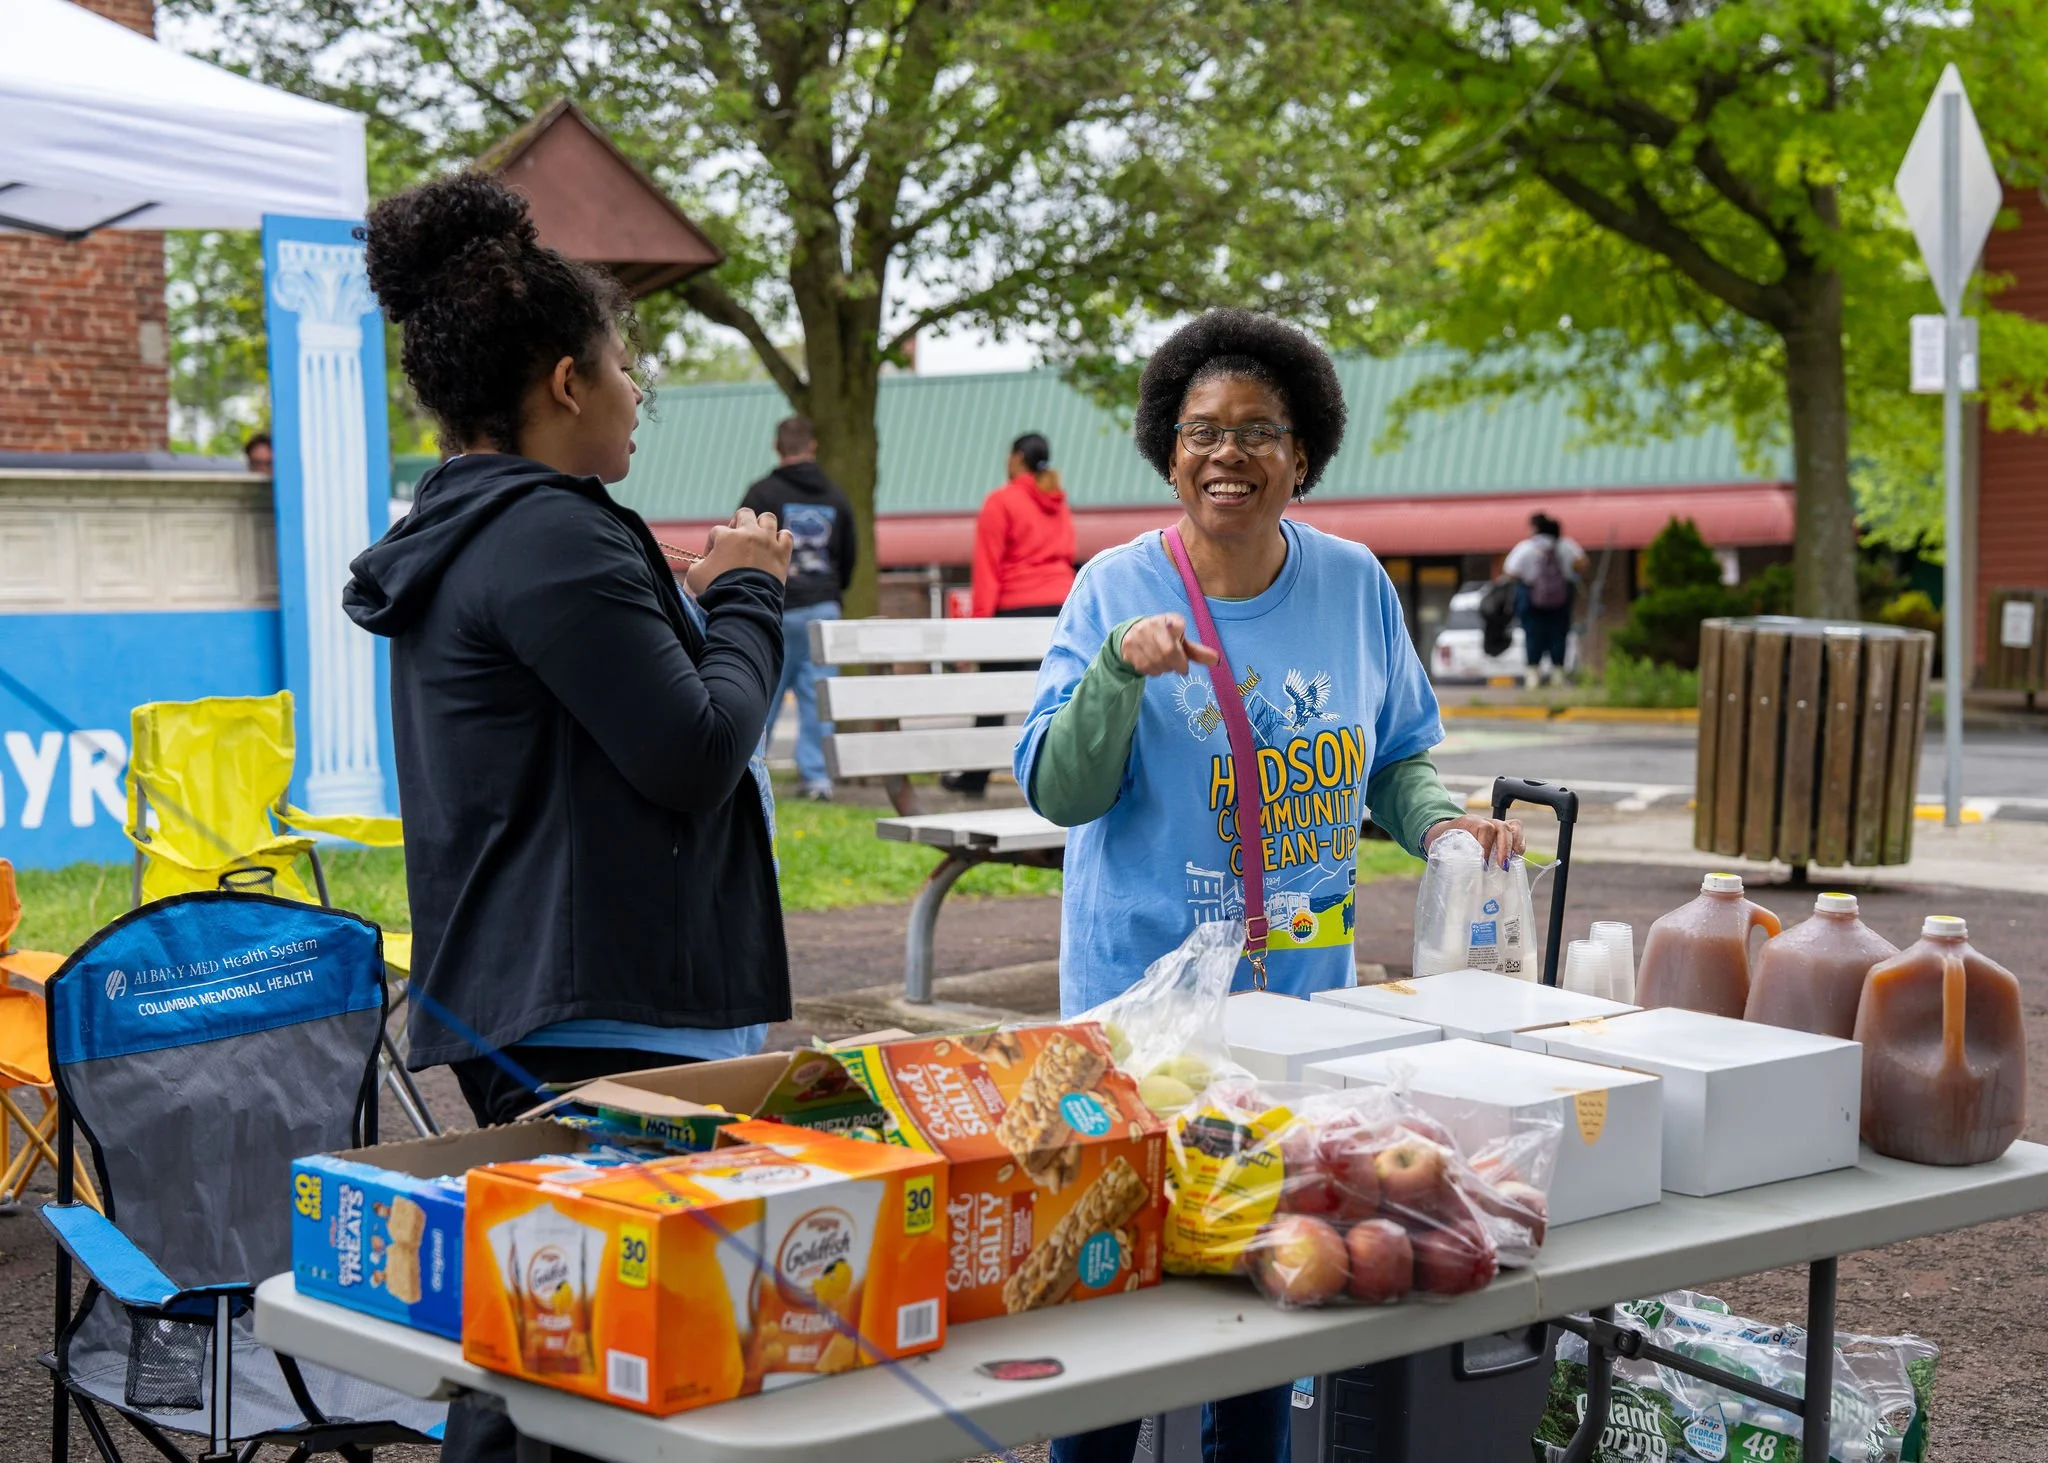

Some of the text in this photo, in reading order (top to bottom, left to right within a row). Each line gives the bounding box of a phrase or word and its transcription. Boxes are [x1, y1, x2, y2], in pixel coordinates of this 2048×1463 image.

[1236, 664, 1262, 697] nual
[1209, 724, 1366, 811] HDSON
[1229, 825, 1358, 878] CEAN-UP
[133, 938, 318, 986] ALBANY MED Health System
[138, 969, 314, 1017] COLUMBIA MEMORIAL HEALTH
[852, 1112, 887, 1127] PACK
[927, 1063, 988, 1136] SALTY
[295, 1173, 312, 1216] 60
[907, 1186, 931, 1212] 30
[348, 1190, 364, 1283] TREATS
[621, 1236, 647, 1264] 30
[785, 1231, 850, 1273] Goldfish
[945, 1193, 974, 1292] Sweet
[978, 1192, 1004, 1285] SALTY
[1576, 1393, 1664, 1438] Pland
[1688, 1427, 1724, 1441] HYDRATE
[1700, 1417, 1720, 1430] drop
[1598, 1426, 1668, 1463] pring
[1742, 1431, 1778, 1462] 48
